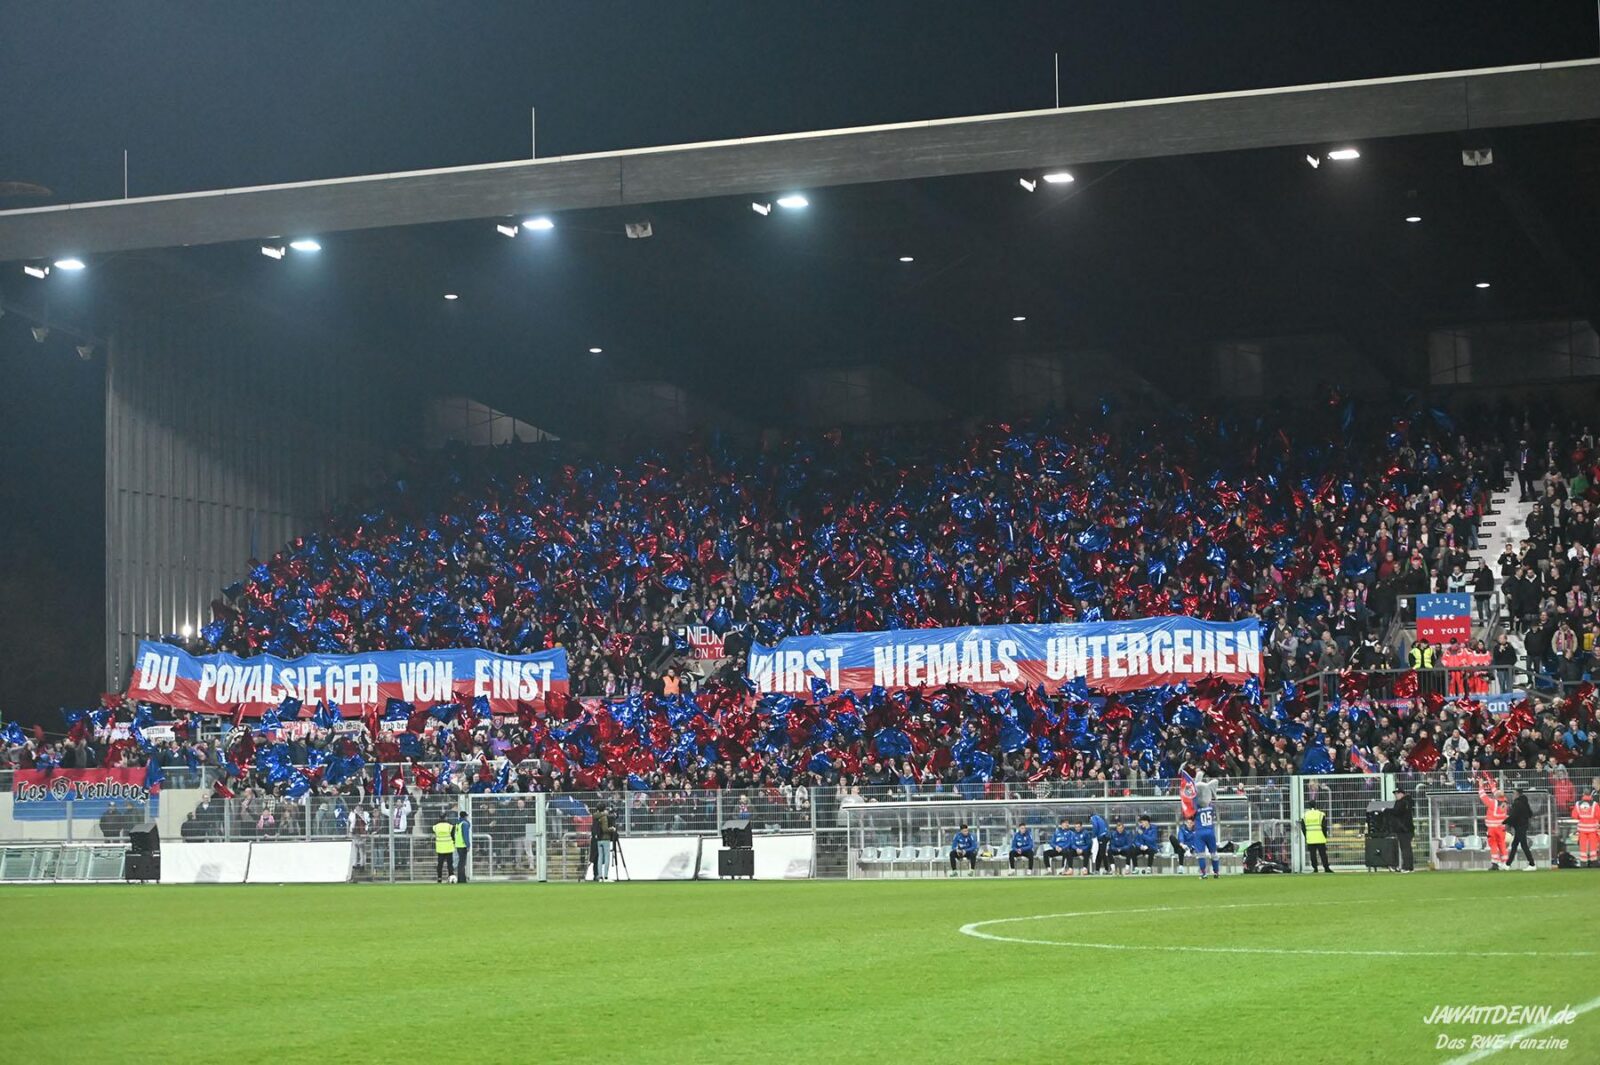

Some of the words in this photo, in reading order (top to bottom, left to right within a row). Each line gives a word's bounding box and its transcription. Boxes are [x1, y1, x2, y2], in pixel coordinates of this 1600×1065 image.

[1421, 597, 1466, 612] EYLLER
[1441, 627, 1465, 635] TOUR
[694, 648, 708, 658] ON
[749, 648, 843, 693] WIRST
[873, 639, 1019, 687] NIEMALS
[1046, 629, 1260, 681] UNTERGEHEN
[139, 652, 179, 694] DU
[198, 663, 378, 705] POKALSIEGER
[399, 660, 453, 702] VON
[474, 659, 554, 701] EINST
[16, 780, 47, 802] Los
[1200, 811, 1212, 826] 05
